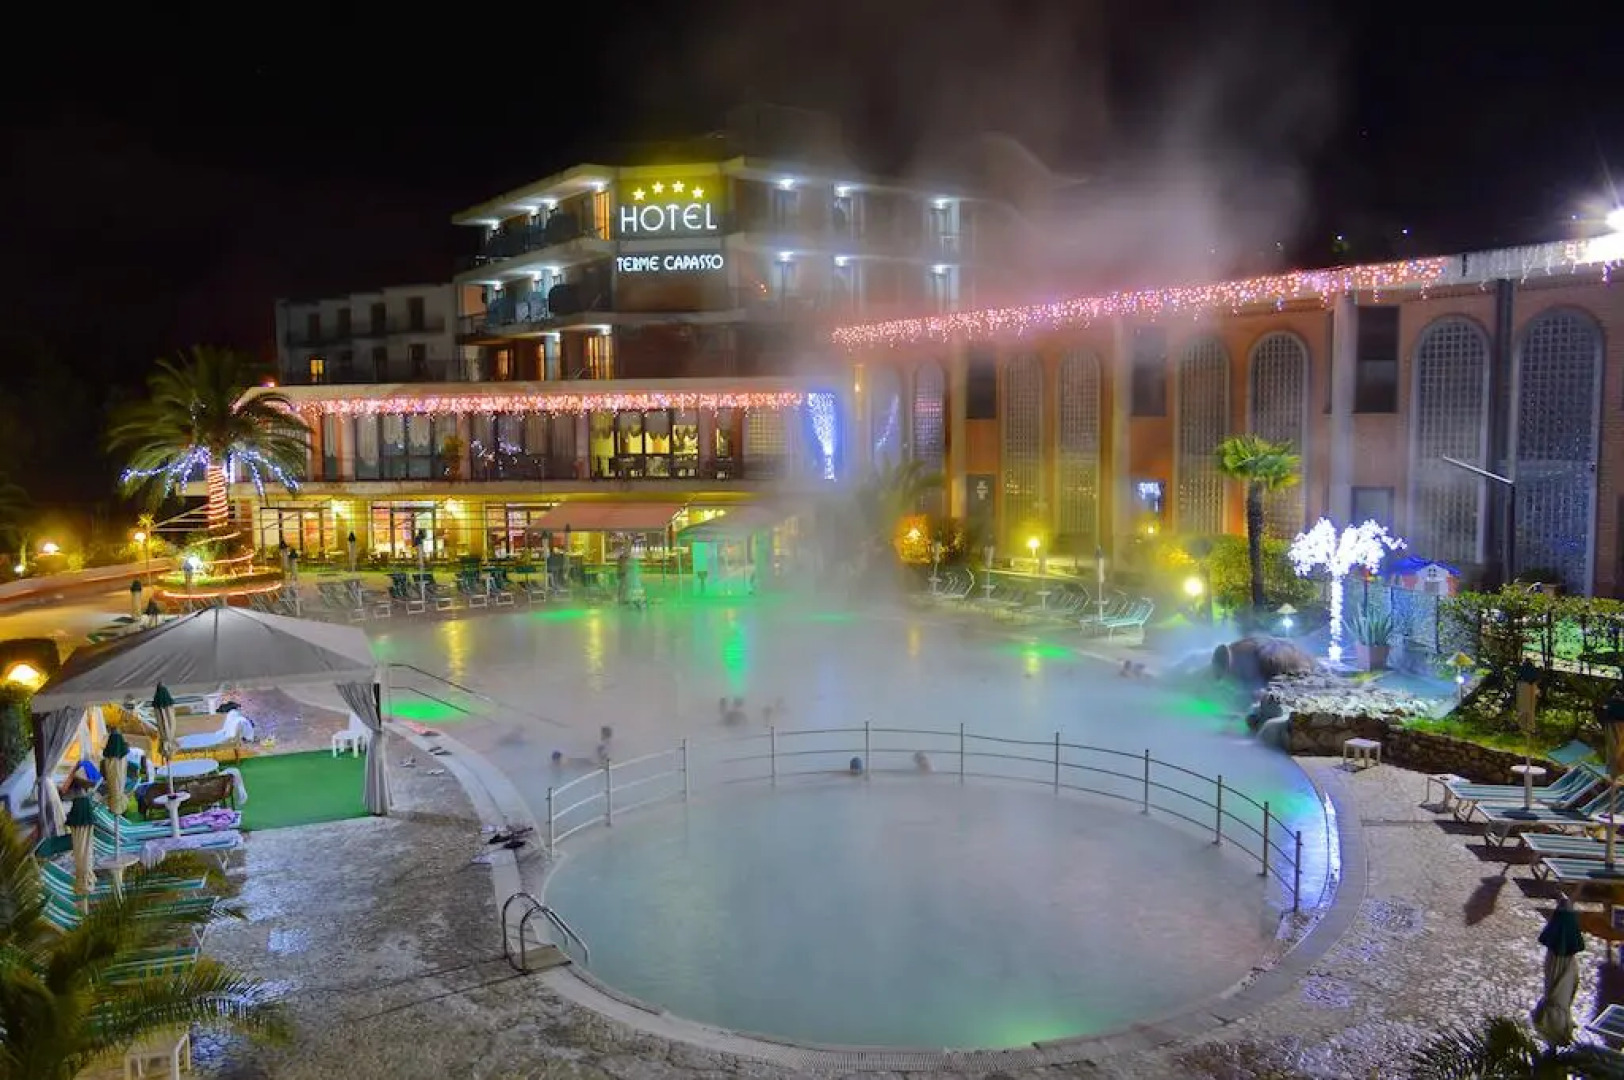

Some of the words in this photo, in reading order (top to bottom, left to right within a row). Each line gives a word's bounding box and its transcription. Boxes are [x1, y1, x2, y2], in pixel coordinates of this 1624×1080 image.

[620, 203, 718, 233] HOTEL
[616, 256, 660, 272] TERME
[663, 254, 724, 271] CAPASSO
